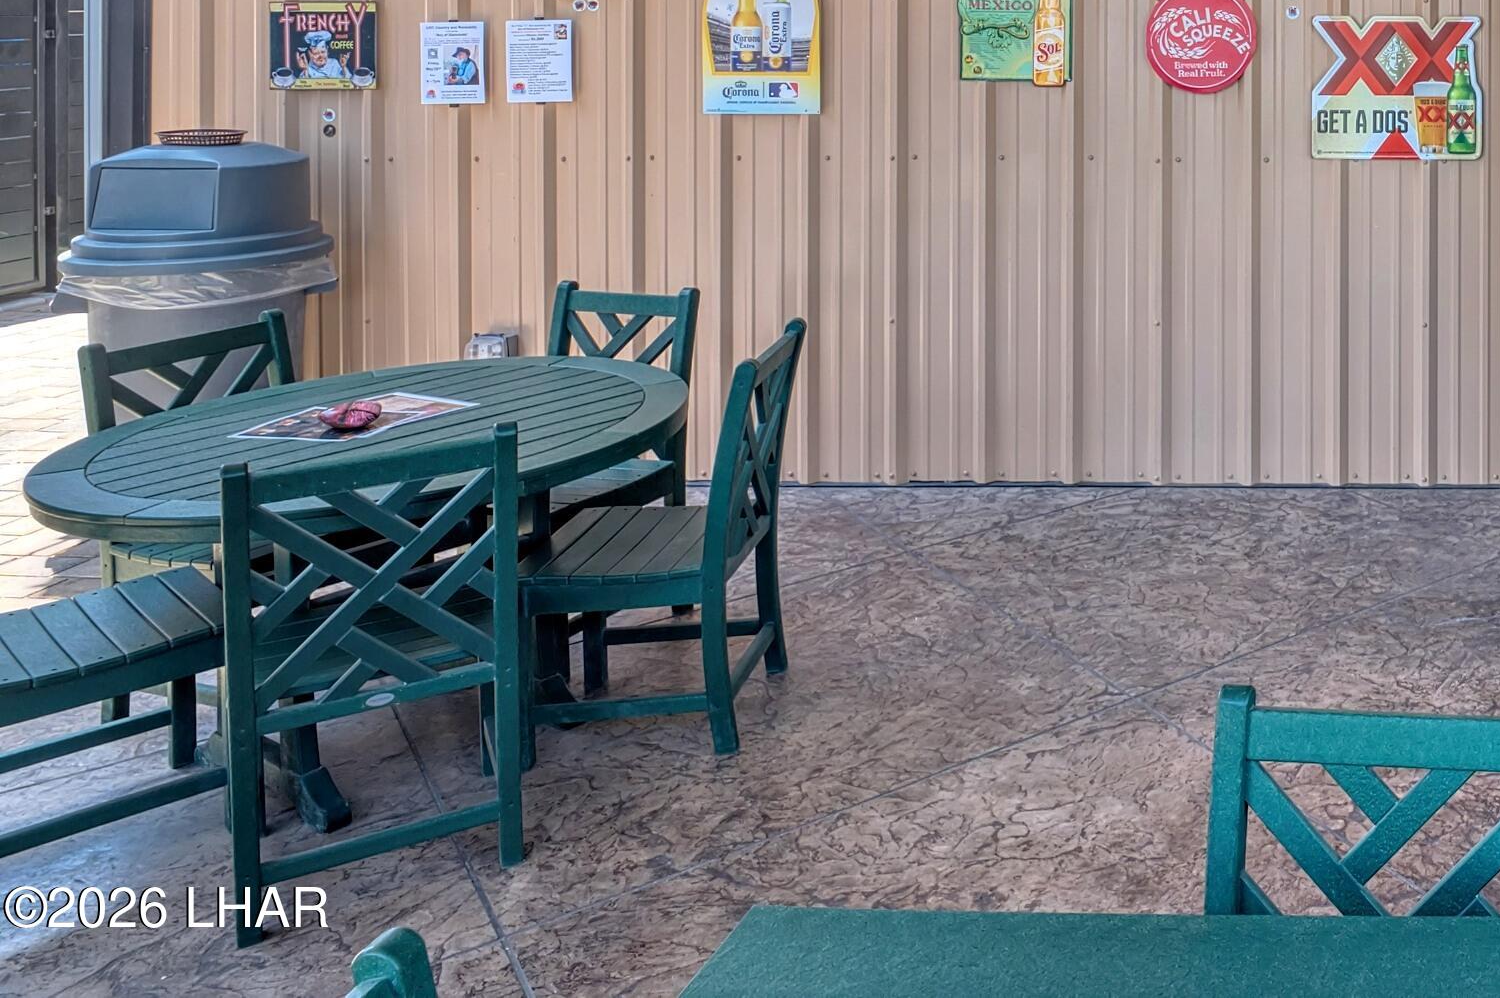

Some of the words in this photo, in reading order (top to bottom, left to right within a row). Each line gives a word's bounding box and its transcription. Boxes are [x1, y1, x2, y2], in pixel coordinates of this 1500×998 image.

[770, 11, 783, 54] Corona
[780, 21, 788, 43] Extra
[1169, 6, 1212, 38] CALI
[279, 3, 368, 70] FRENCHY
[330, 40, 354, 49] COFFEE
[733, 34, 761, 45] Corona
[1182, 24, 1251, 55] SQUEEZE
[1174, 61, 1208, 70] Brewed
[1208, 60, 1229, 69] with
[1178, 69, 1199, 78] Real
[722, 86, 760, 100] Corona
[1316, 109, 1351, 134] GET
[1355, 109, 1368, 134] A
[1372, 110, 1409, 134] DOS
